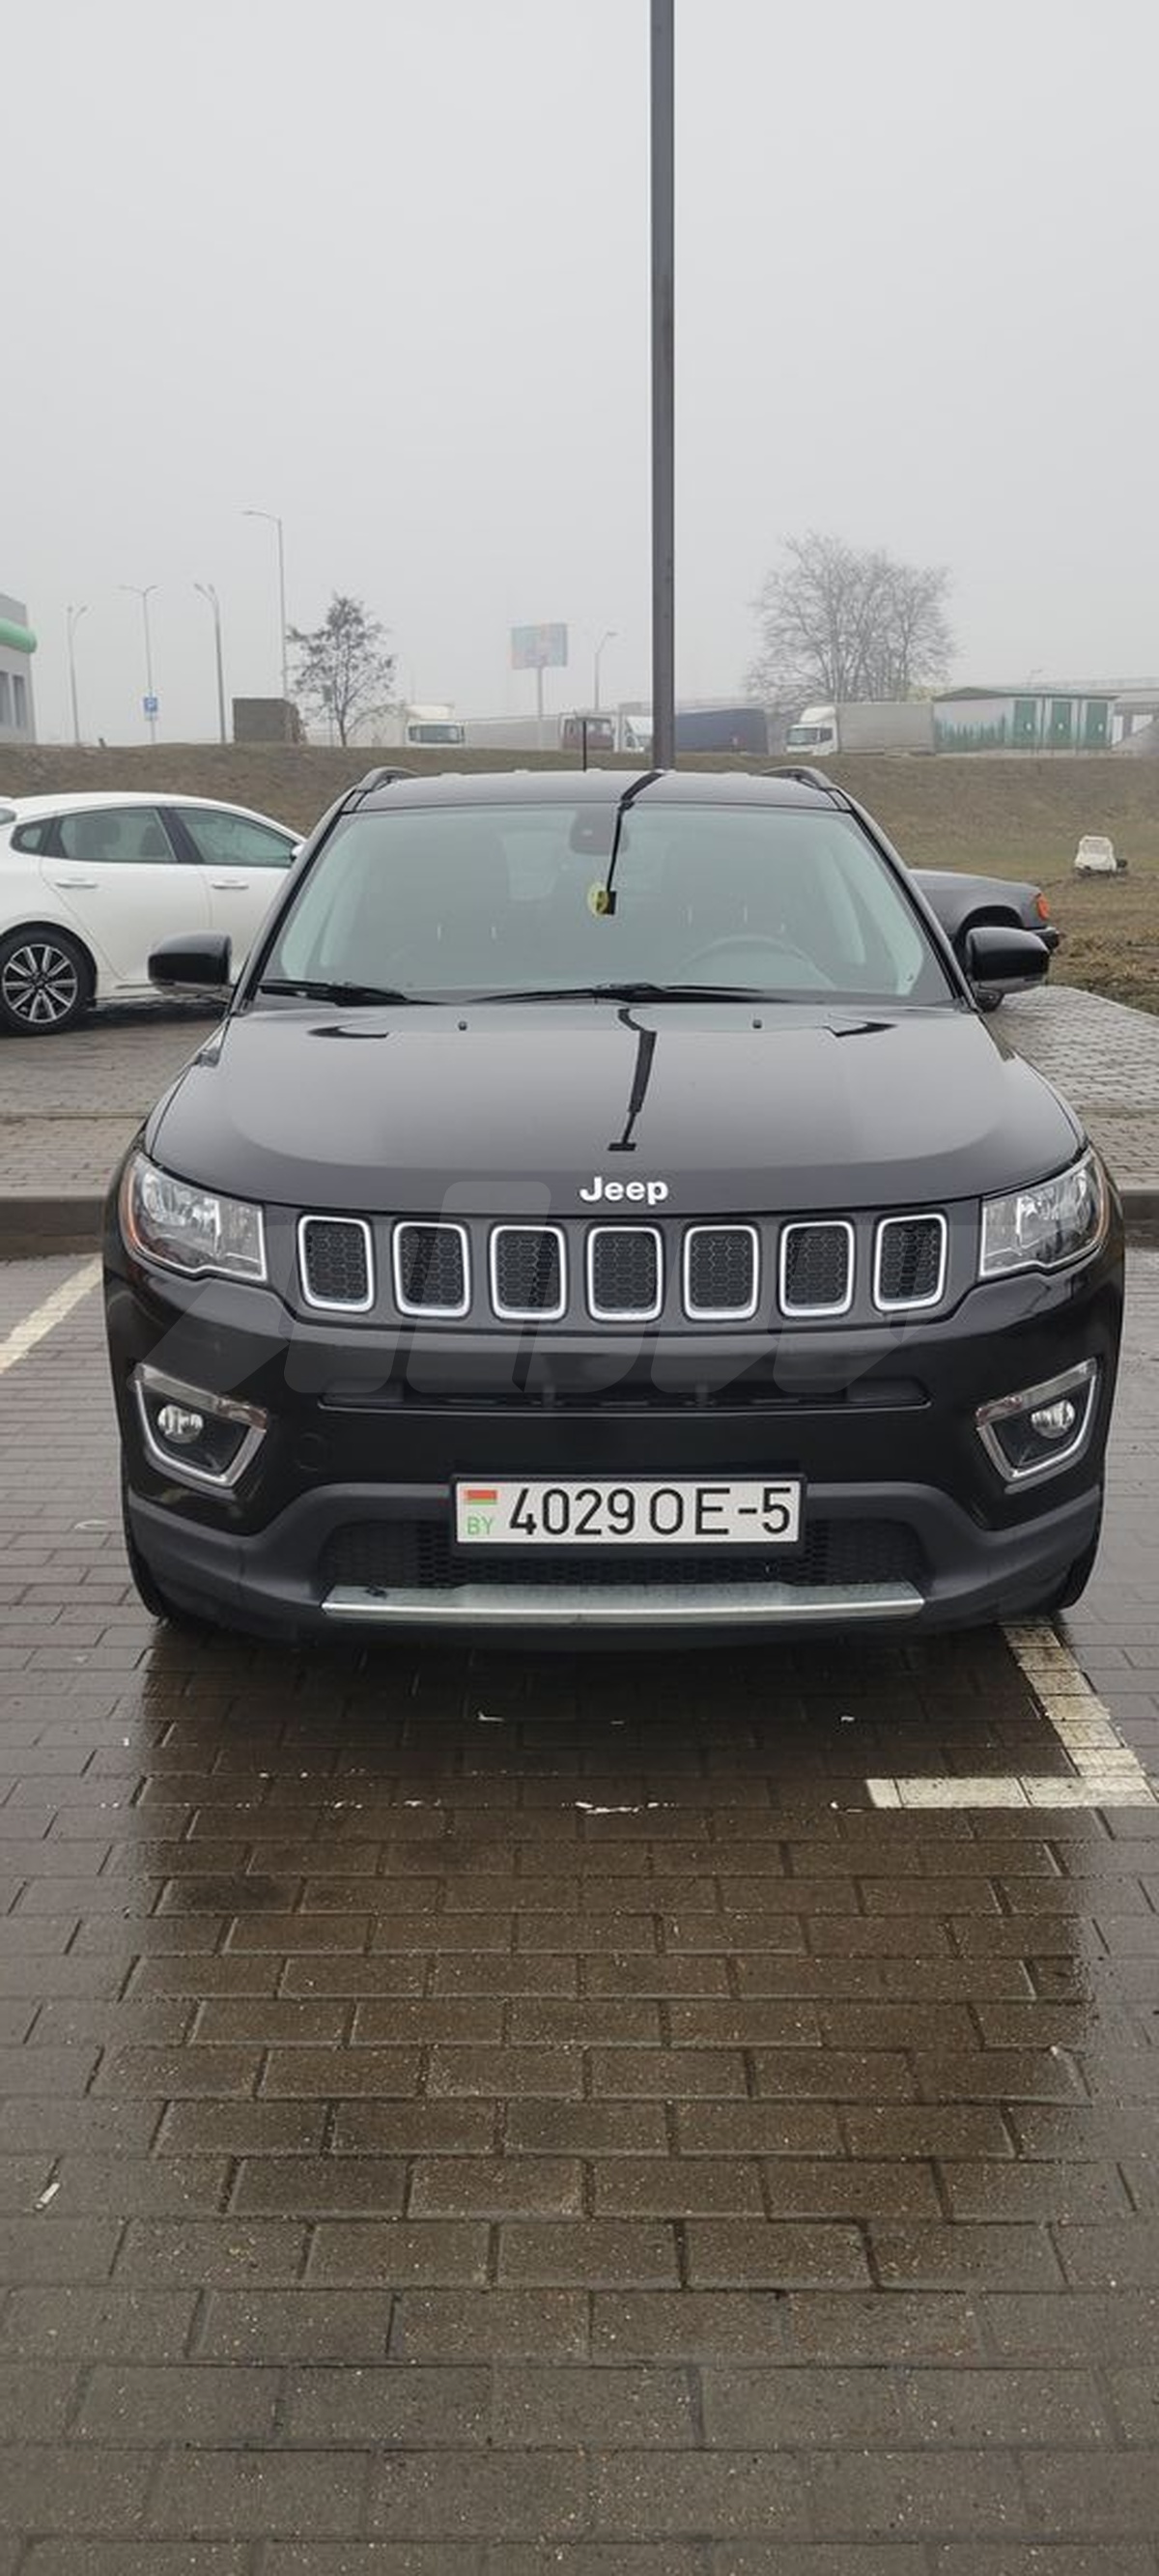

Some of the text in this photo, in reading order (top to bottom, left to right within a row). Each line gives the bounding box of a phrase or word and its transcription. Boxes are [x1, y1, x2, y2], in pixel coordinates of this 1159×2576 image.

[580, 1176, 668, 1205] Jeep
[466, 1516, 494, 1535] BY
[509, 1487, 792, 1535] 4029 OE-5
